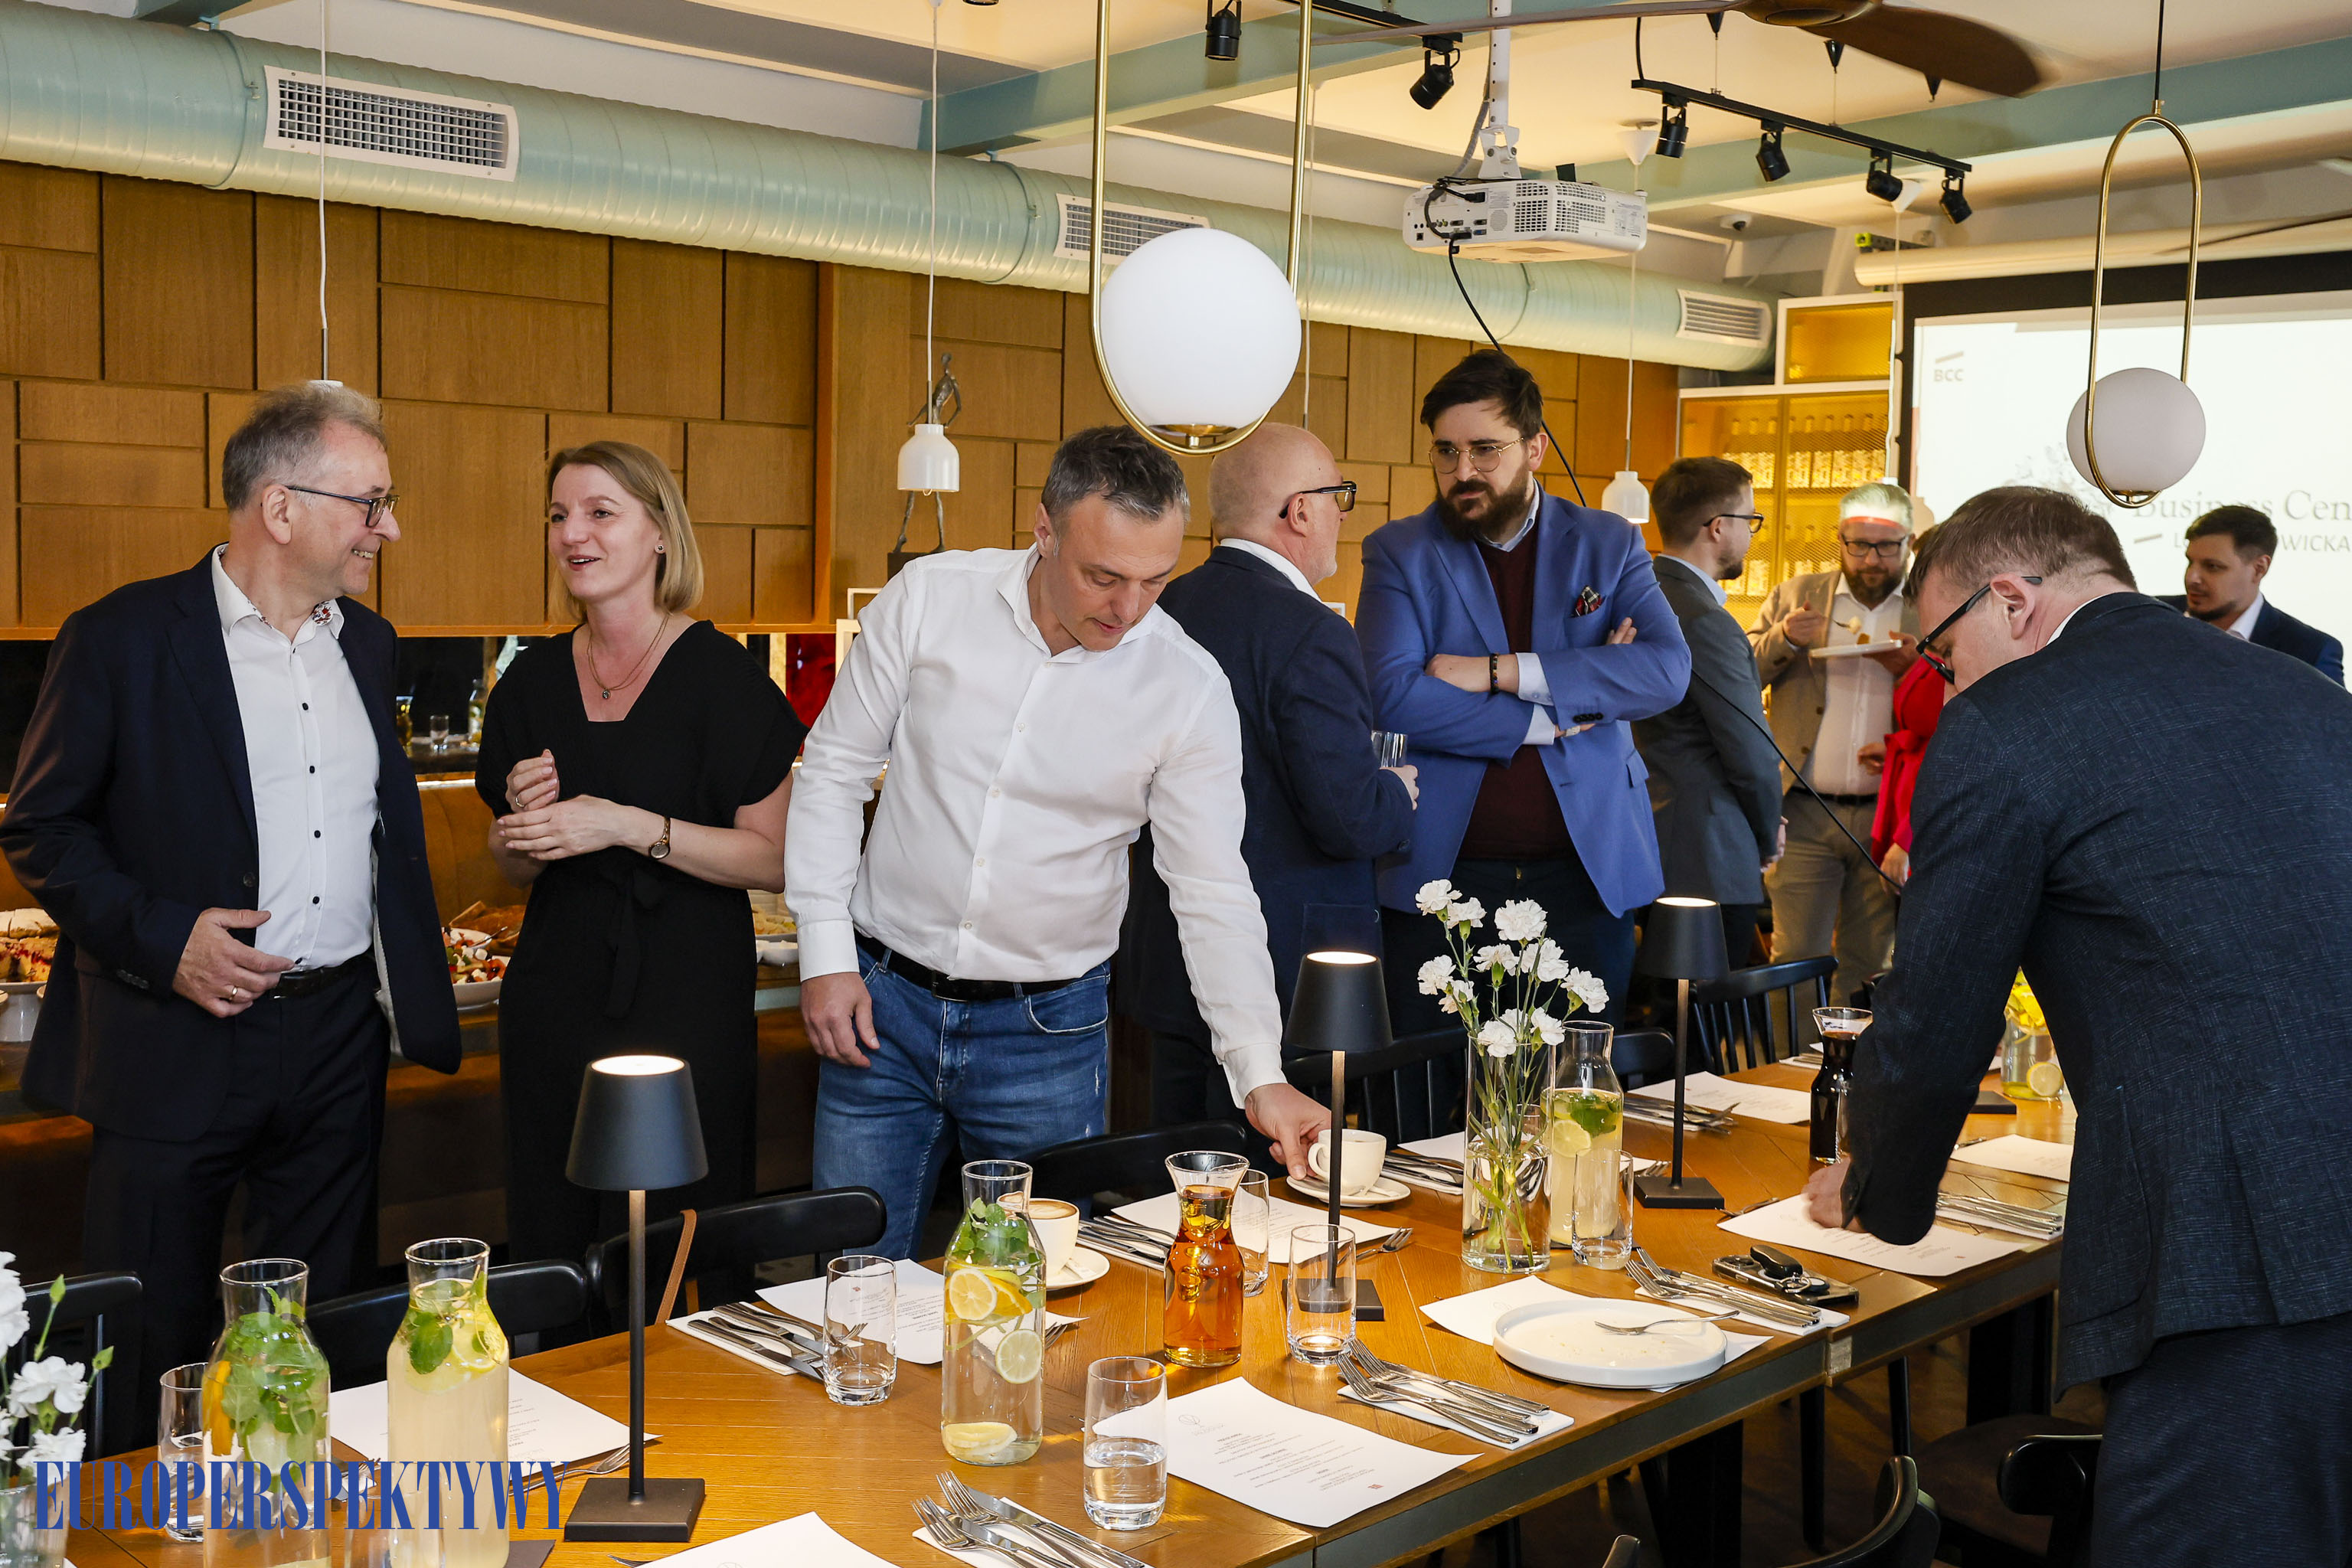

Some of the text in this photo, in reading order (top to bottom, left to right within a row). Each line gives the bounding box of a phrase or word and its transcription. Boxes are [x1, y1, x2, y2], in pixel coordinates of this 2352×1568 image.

[1933, 368, 1965, 382] BCC
[2132, 489, 2352, 521] Busis Cen
[2279, 534, 2352, 552] WICKA
